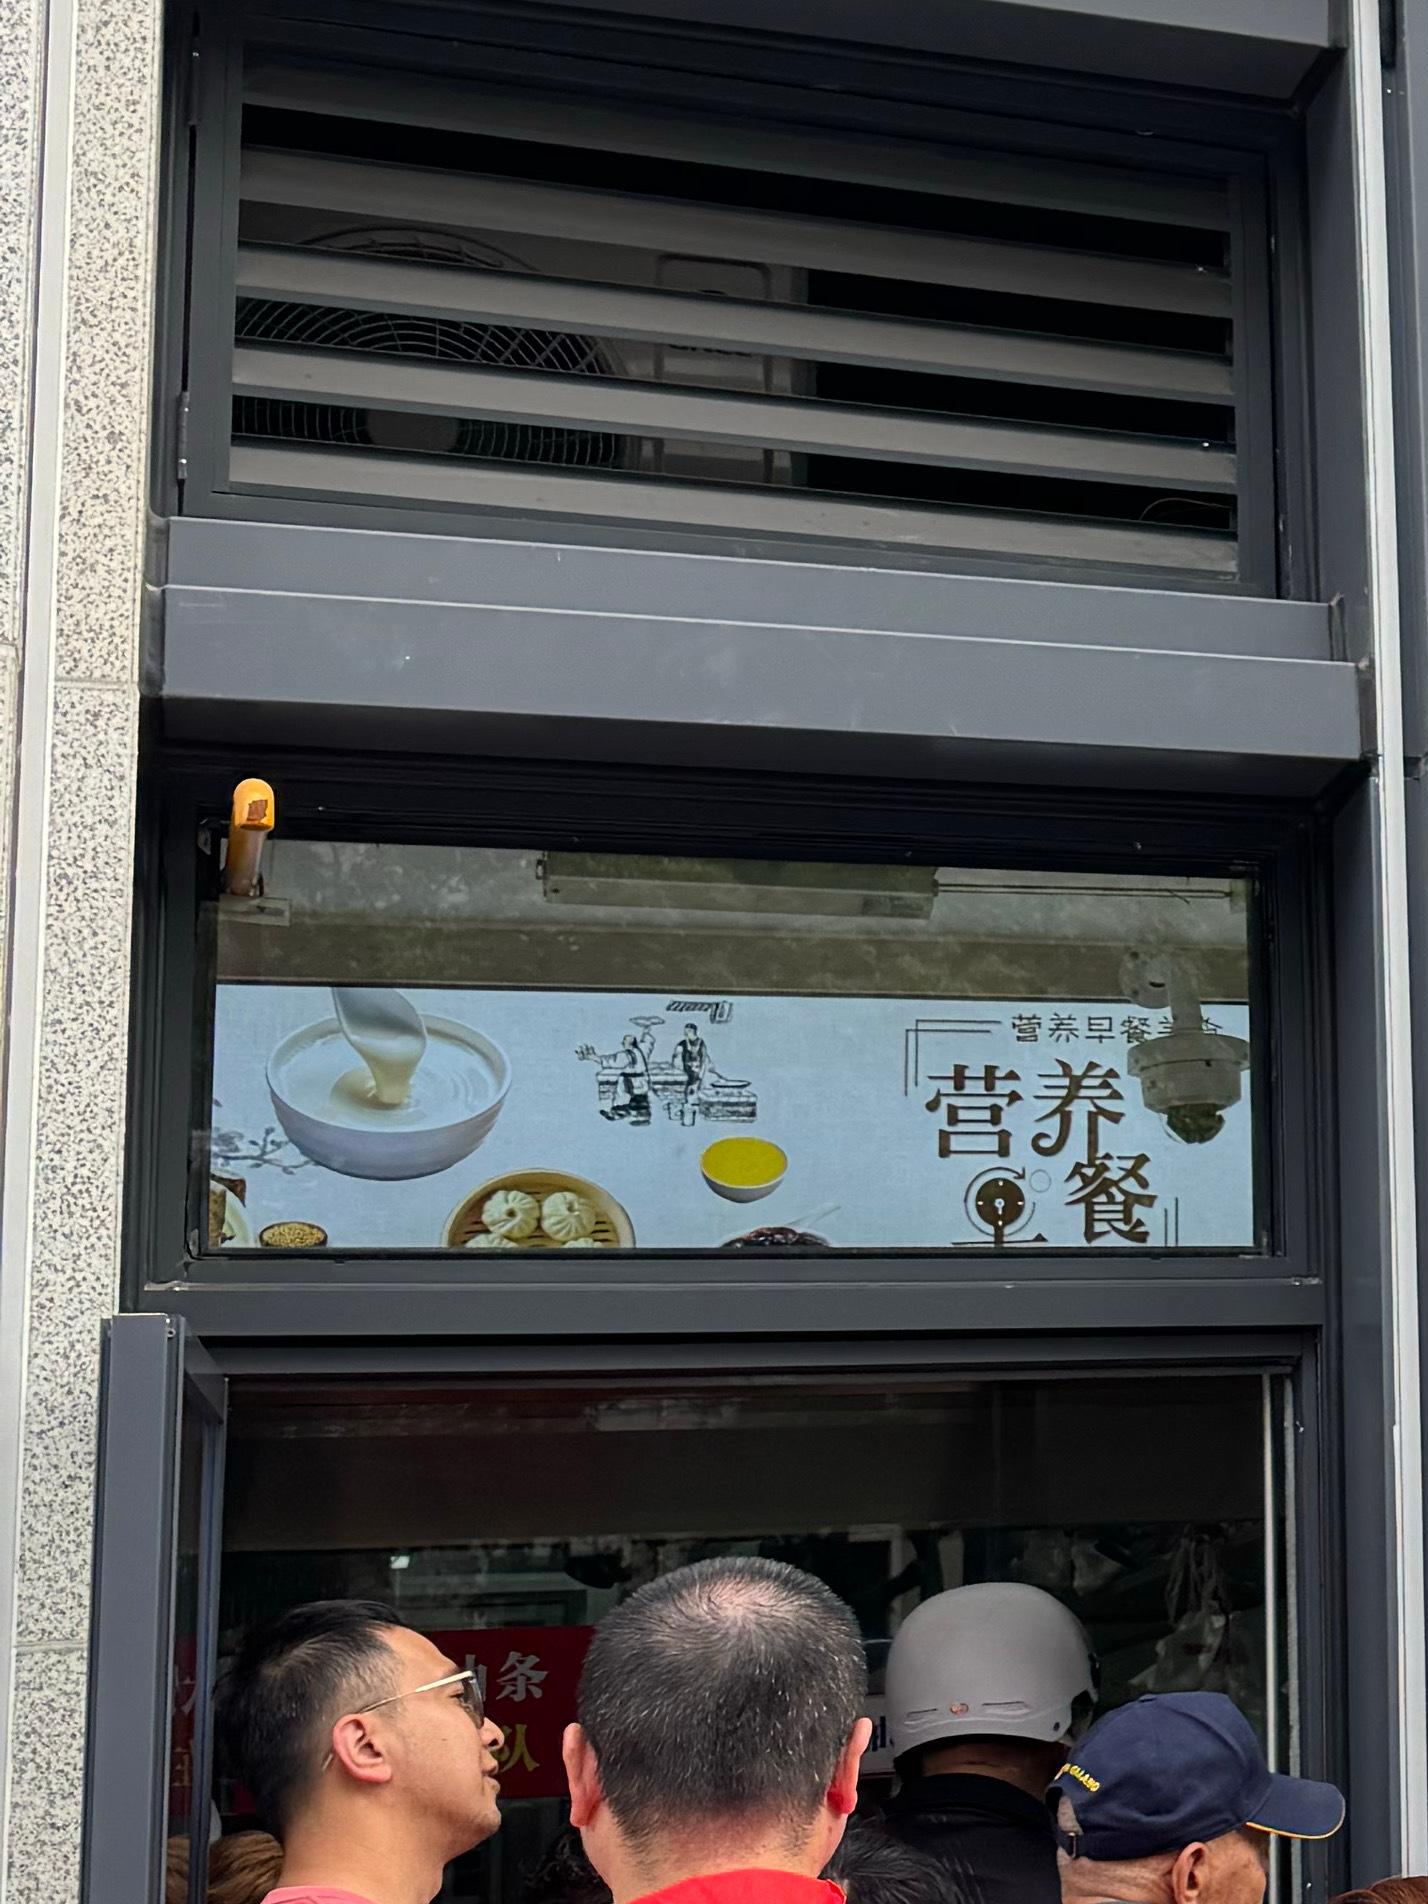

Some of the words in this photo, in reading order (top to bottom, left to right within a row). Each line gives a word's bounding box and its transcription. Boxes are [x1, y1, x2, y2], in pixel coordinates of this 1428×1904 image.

[1012, 1013, 1224, 1045] 营养早餐
[925, 1058, 1128, 1165] 营养
